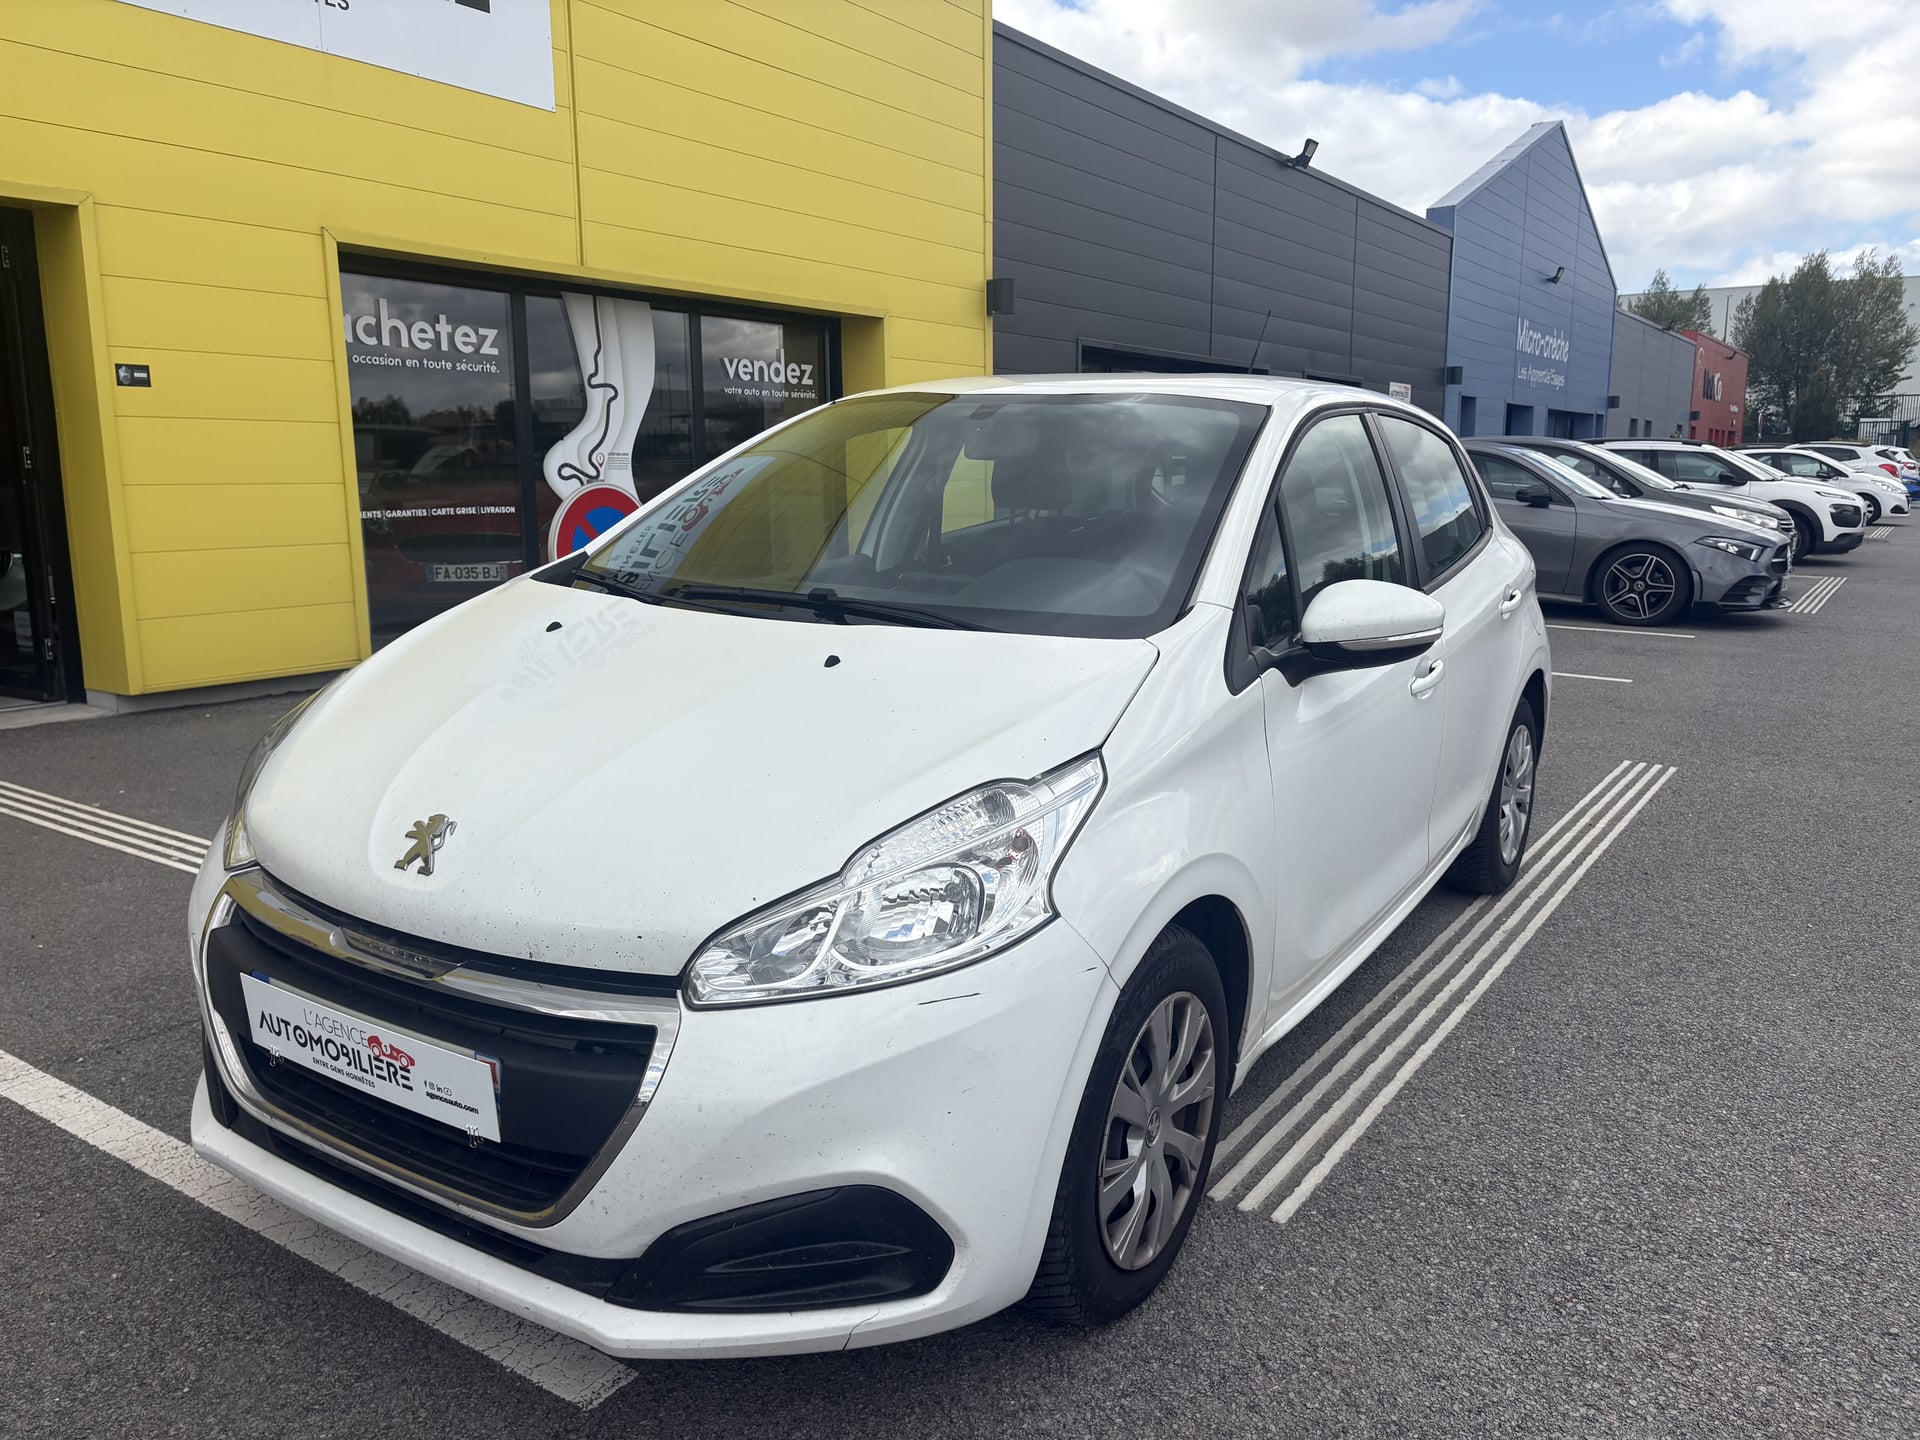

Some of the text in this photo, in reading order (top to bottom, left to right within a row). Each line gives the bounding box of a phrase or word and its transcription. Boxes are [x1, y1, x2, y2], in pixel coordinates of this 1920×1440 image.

[352, 353, 500, 374] occasion en toute sécurité.
[723, 348, 814, 385] vendez
[724, 386, 742, 395] votre
[743, 386, 760, 396] auto
[772, 388, 789, 398] toute
[386, 508, 428, 518] GARANTIES
[431, 507, 455, 516] CARTE
[456, 506, 477, 515] GRISE
[481, 505, 516, 514] LIVRAISON
[312, 1056, 376, 1089] ENTRE GENS HONNÊTES
